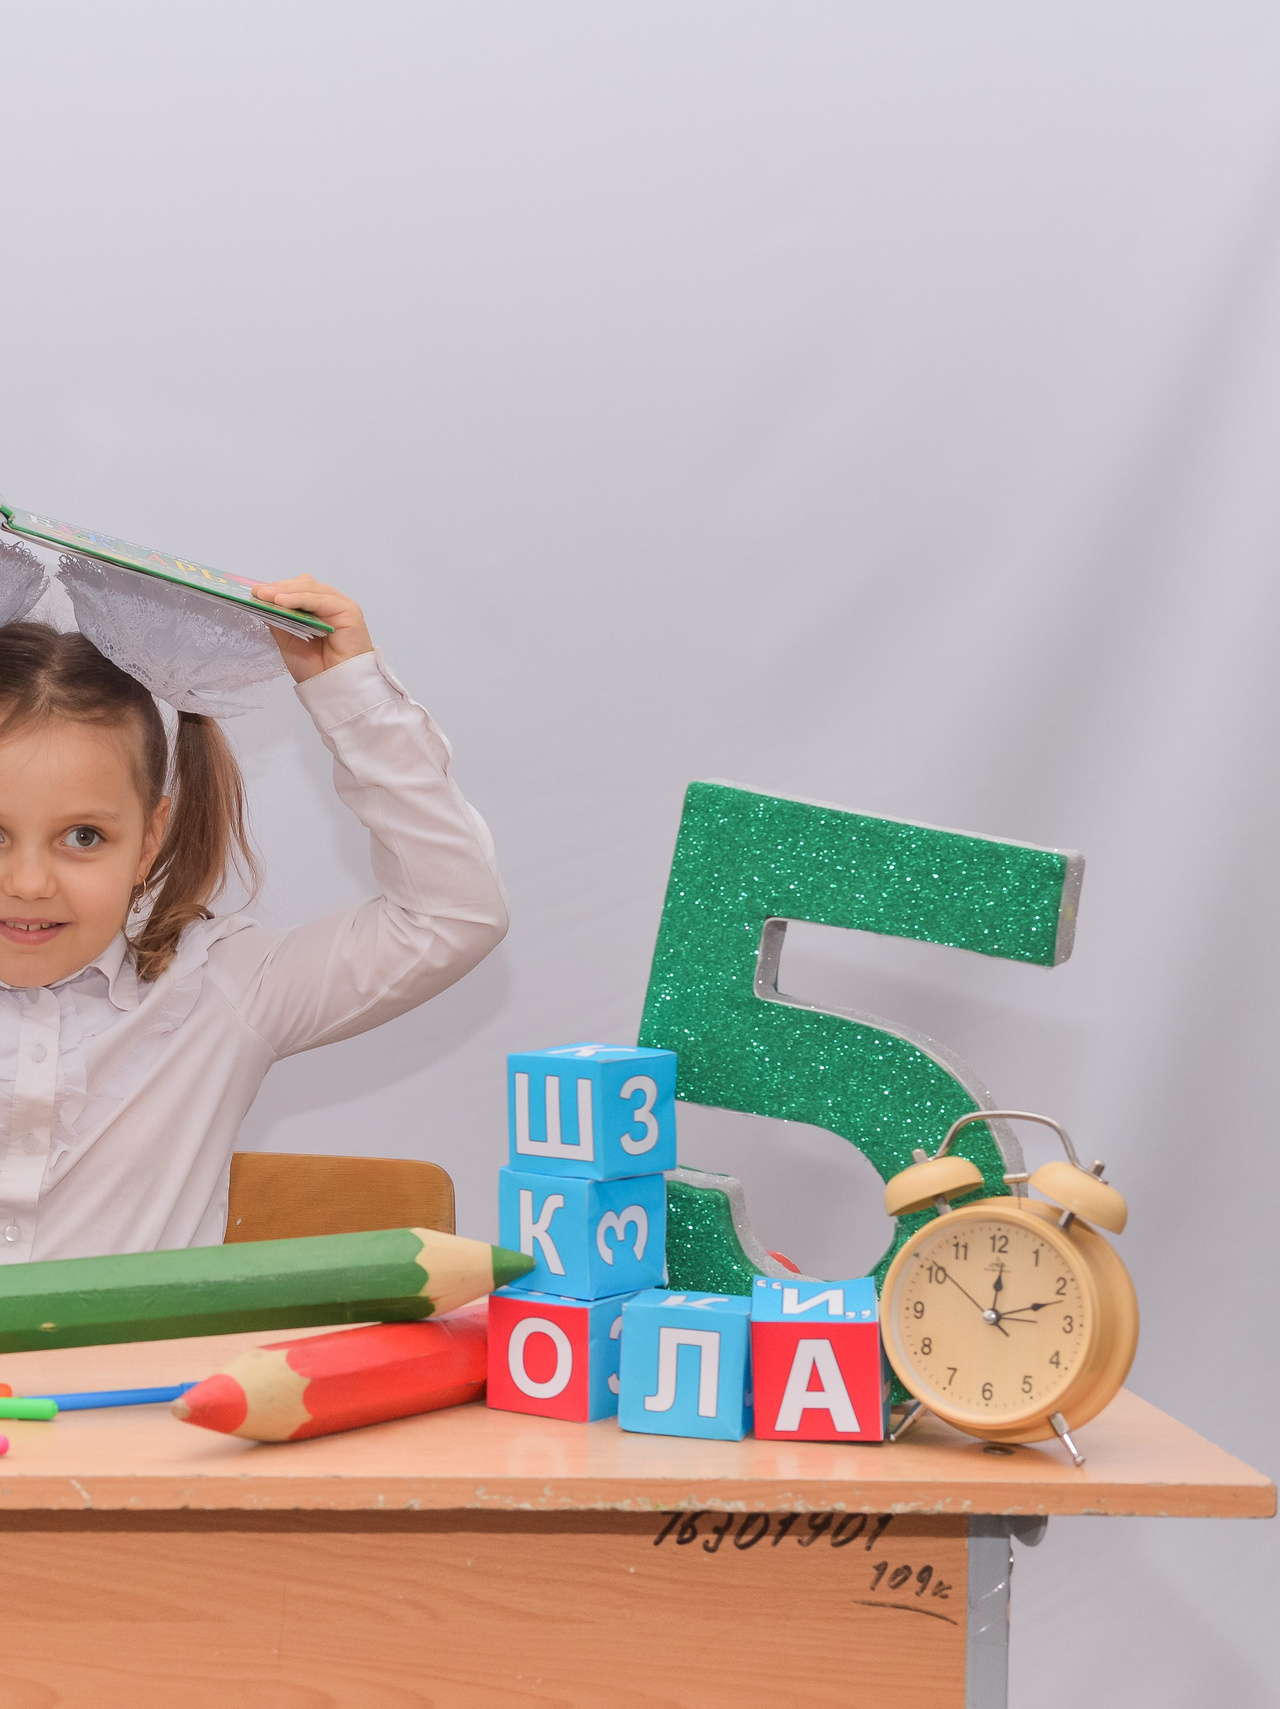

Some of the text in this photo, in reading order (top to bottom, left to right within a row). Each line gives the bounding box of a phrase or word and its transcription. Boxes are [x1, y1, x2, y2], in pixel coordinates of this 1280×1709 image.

[515, 1071, 595, 1163] Ш
[519, 1188, 567, 1277] К
[953, 1241, 968, 1260] 11
[990, 1234, 1009, 1254] 12
[1032, 1249, 1040, 1268] 1
[927, 1265, 946, 1284] 10
[1055, 1277, 1066, 1296] 2
[913, 1301, 925, 1319] 9
[1062, 1315, 1074, 1334] 3
[921, 1337, 932, 1355] 8
[1049, 1350, 1061, 1368] 4
[643, 1326, 721, 1419] Л
[947, 1367, 958, 1386] 7
[773, 1338, 862, 1433] А
[981, 1382, 993, 1400] 6
[1021, 1375, 1033, 1393] 5
